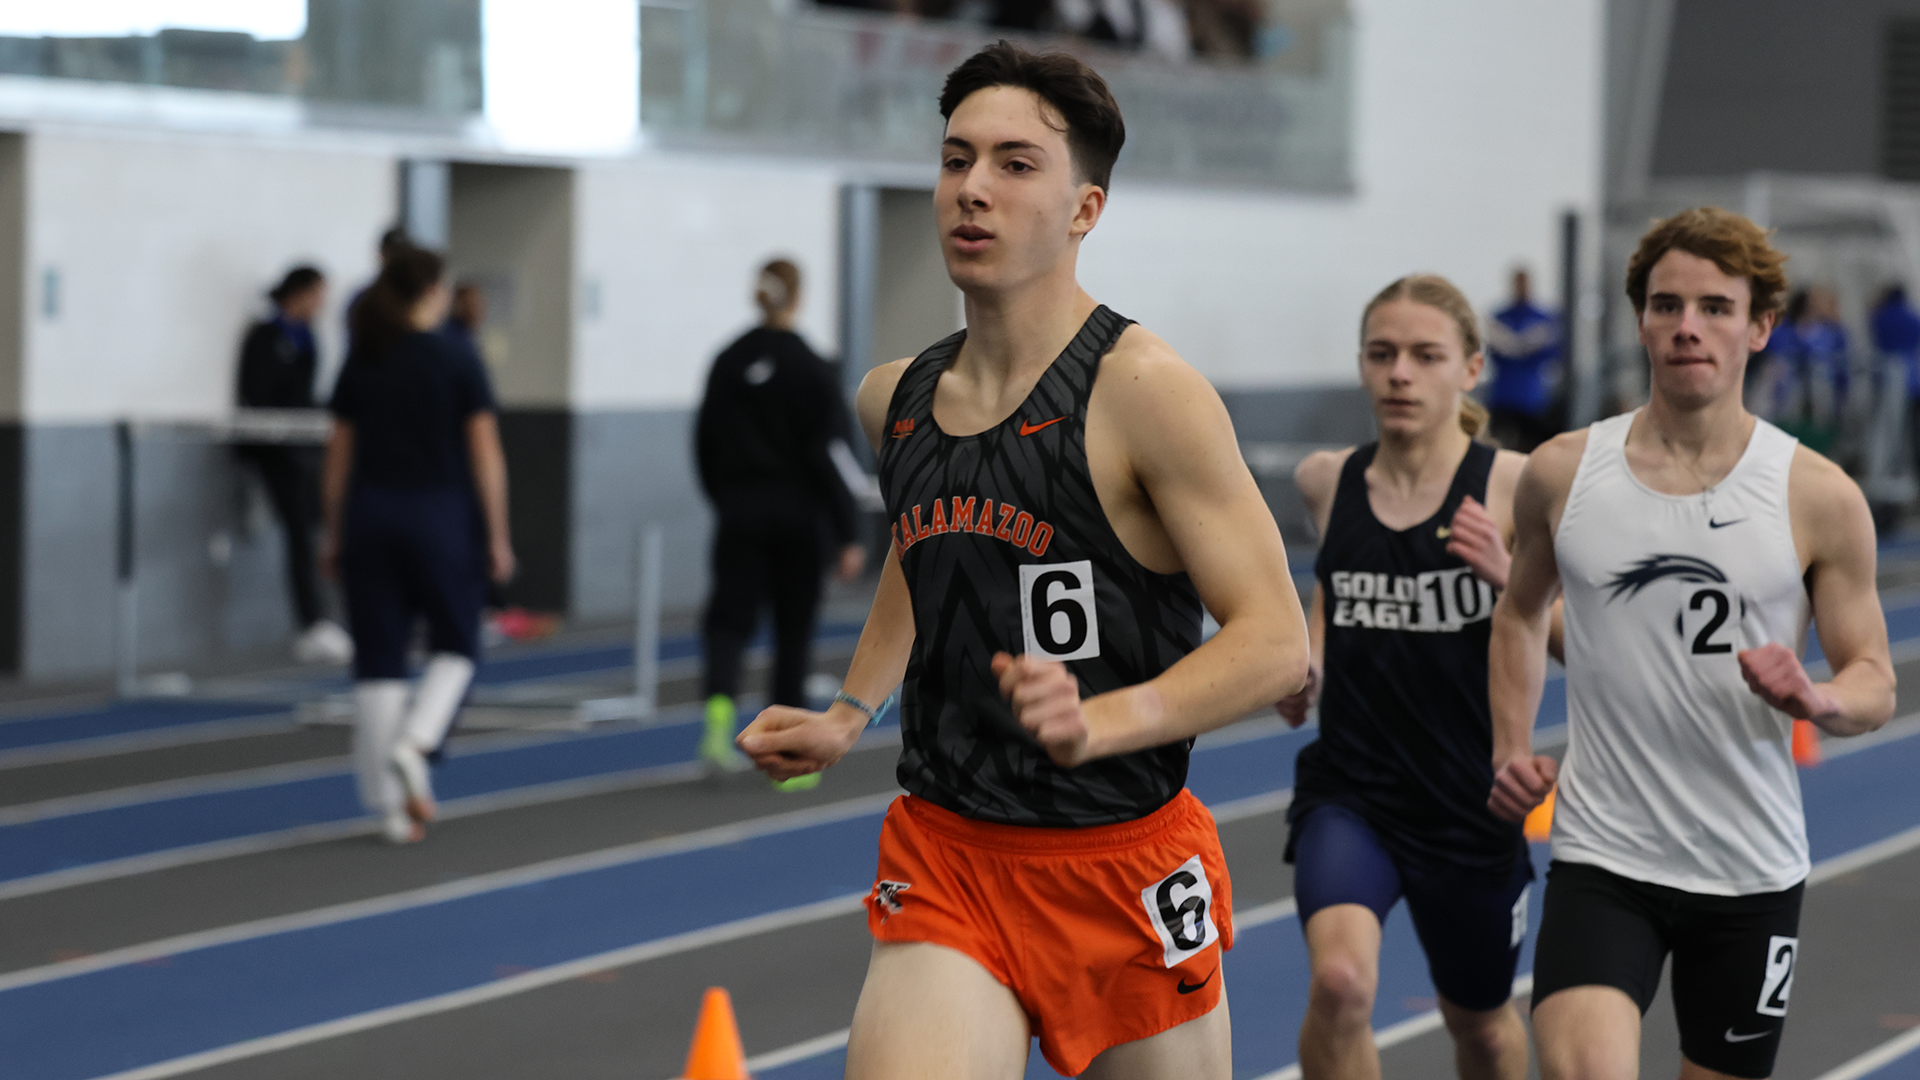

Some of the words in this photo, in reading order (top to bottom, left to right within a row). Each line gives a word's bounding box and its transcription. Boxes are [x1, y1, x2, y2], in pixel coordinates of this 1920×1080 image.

[1031, 570, 1088, 655] 6
[1331, 571, 1416, 601] GOLD
[1333, 600, 1462, 632] EAGL
[1425, 572, 1481, 619] 10
[1689, 588, 1733, 655] 2
[1156, 870, 1206, 951] 6
[1765, 944, 1793, 1009] 2
